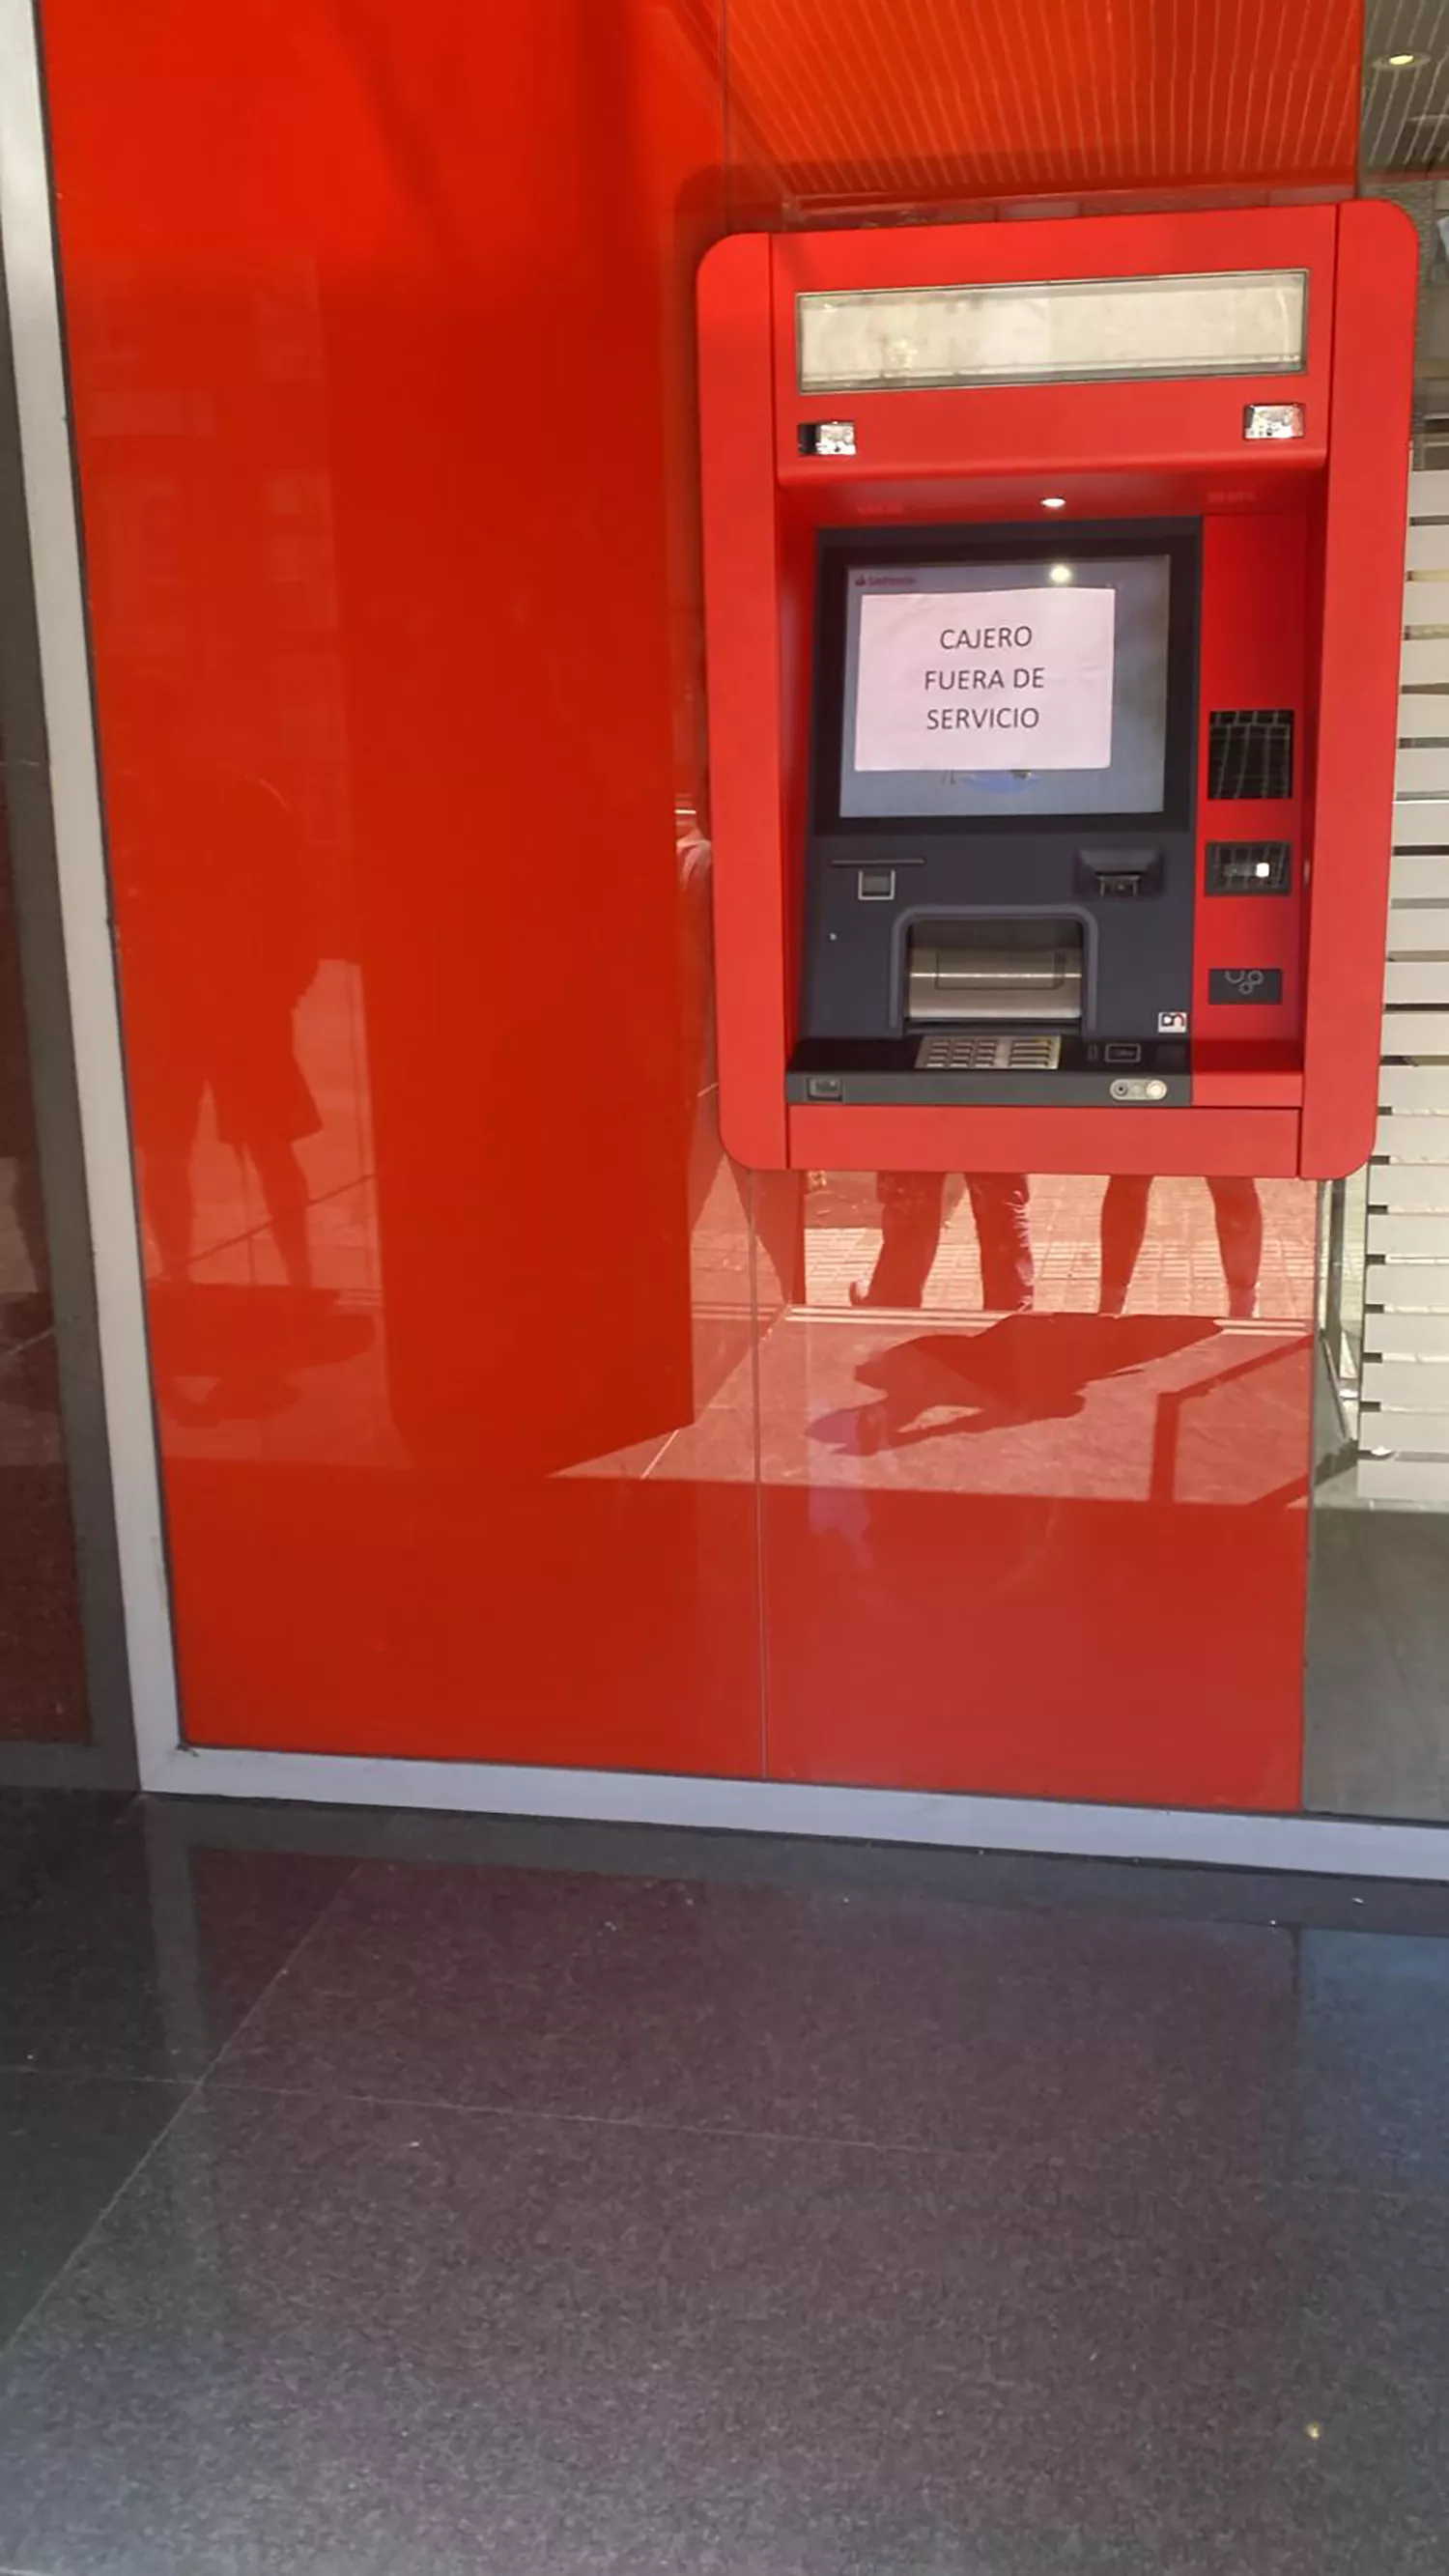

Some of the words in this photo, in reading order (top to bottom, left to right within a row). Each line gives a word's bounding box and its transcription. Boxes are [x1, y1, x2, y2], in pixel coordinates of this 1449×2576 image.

[940, 626, 1033, 650] CAJERO
[924, 669, 1005, 691] FUERA
[1013, 667, 1045, 689] DE
[926, 707, 1040, 730] SERVICIO
